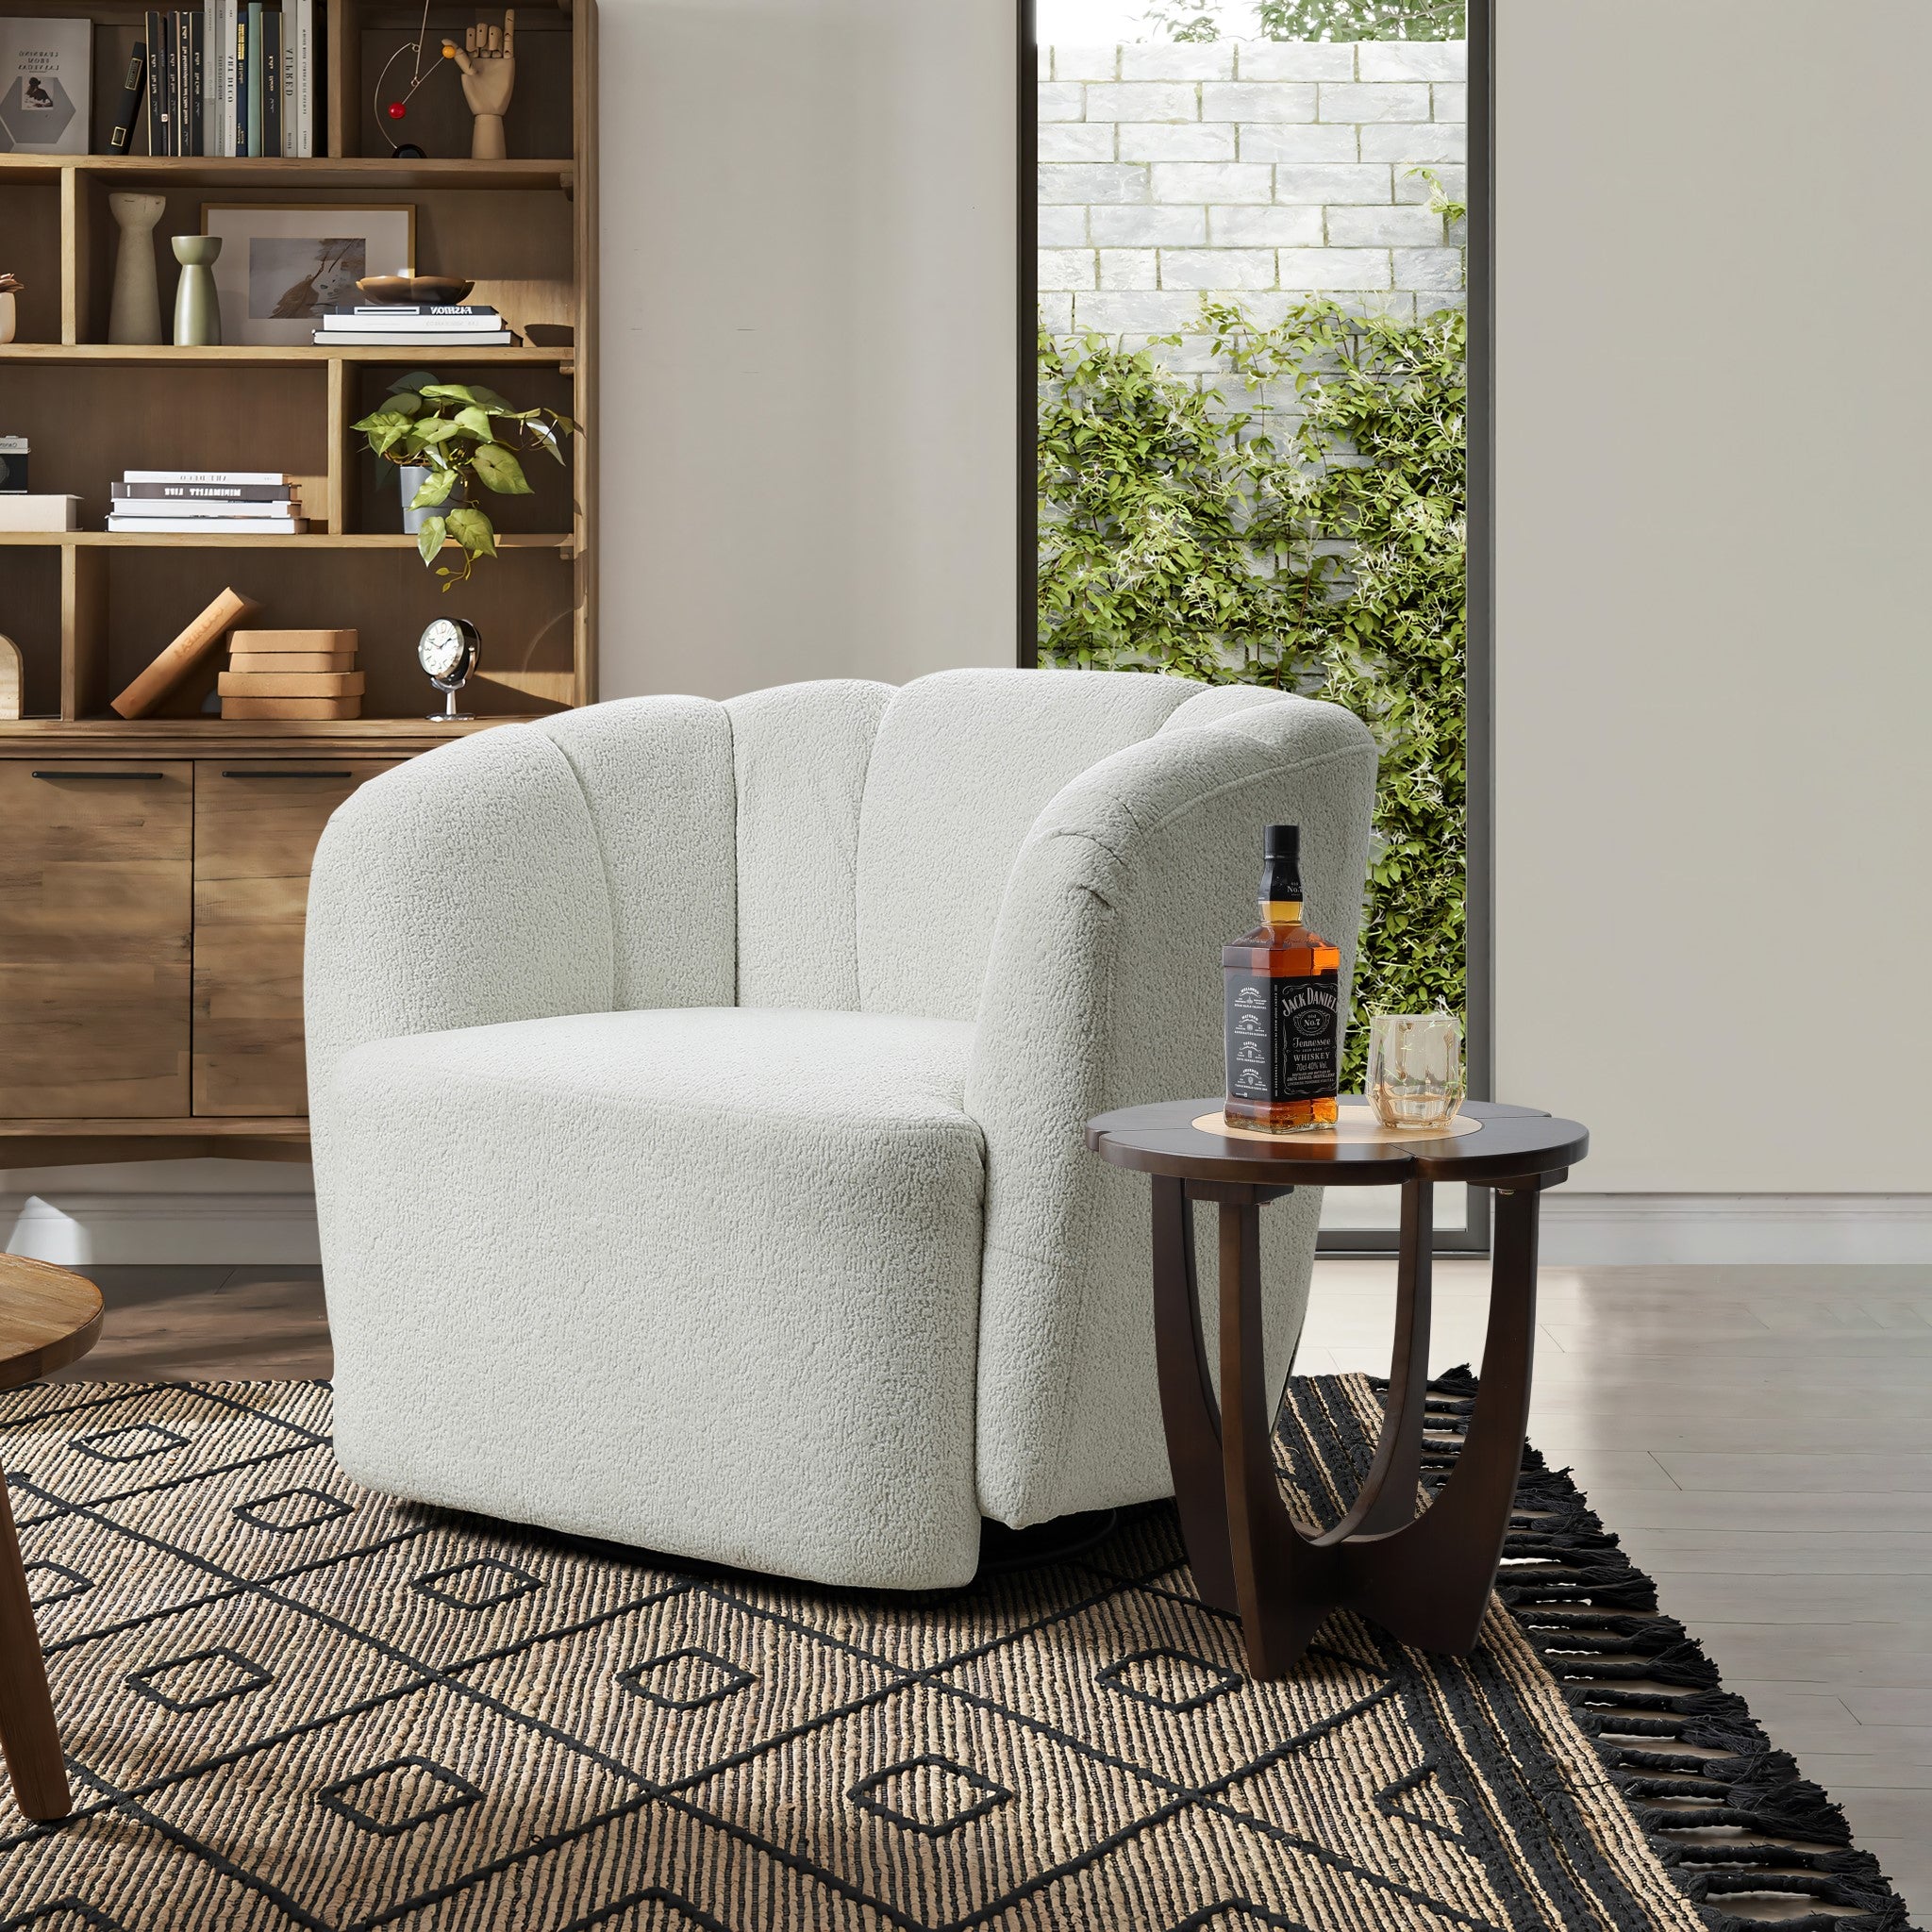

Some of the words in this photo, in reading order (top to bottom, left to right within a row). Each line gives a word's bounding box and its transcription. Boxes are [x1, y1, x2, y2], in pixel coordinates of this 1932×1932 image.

[1282, 992, 1307, 1017] JACK
[1292, 1038, 1331, 1048] Tennessee
[1293, 1052, 1330, 1062] WHISKEY
